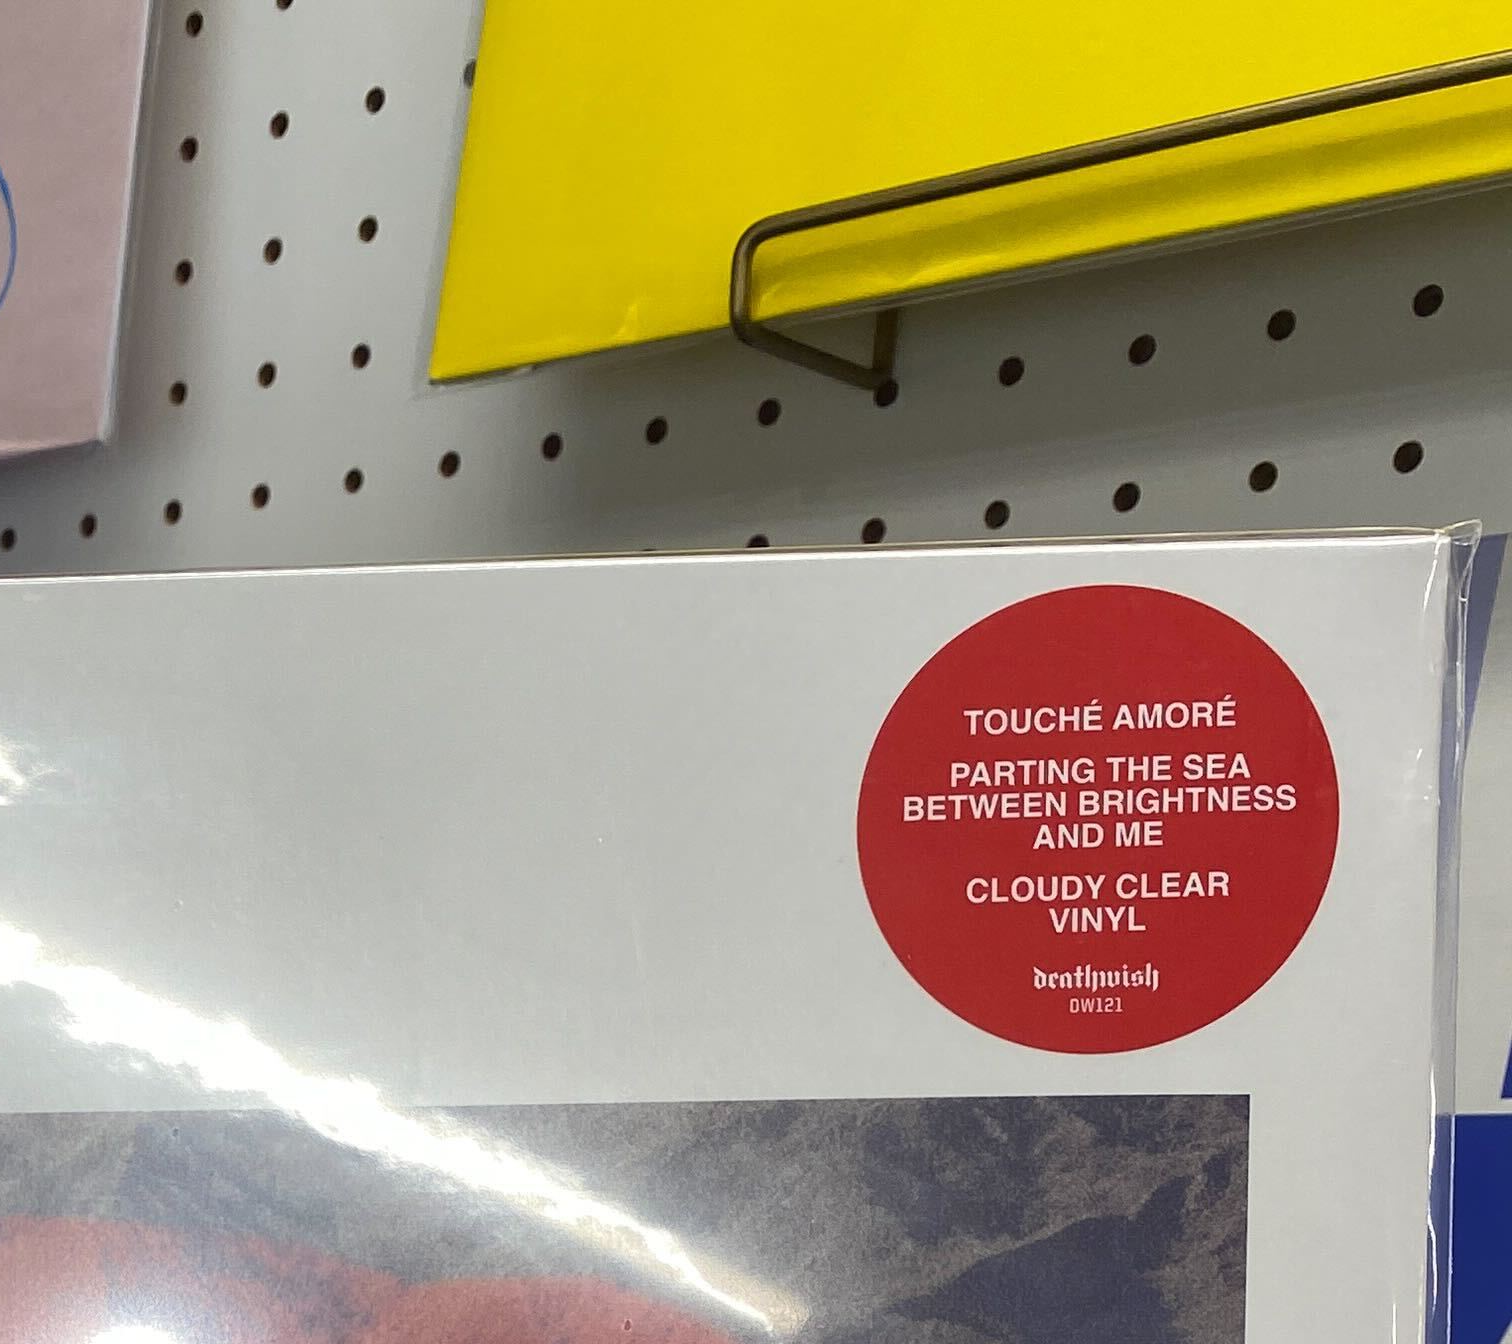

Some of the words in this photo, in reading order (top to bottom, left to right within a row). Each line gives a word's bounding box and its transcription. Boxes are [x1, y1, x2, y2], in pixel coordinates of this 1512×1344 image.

[964, 700, 1103, 735] TOUCHÉ
[1112, 695, 1237, 731] AMORÉ
[950, 757, 1095, 788] PARTING
[1107, 755, 1172, 783] THE
[1183, 753, 1251, 780] SEA
[903, 791, 1067, 823] BETWEEN
[1078, 785, 1297, 817] BRIGHTNESS
[1032, 823, 1104, 850] AND
[1115, 821, 1164, 848] ME
[965, 874, 1105, 904] CLOUDY
[1116, 871, 1230, 899] CLEAR
[1049, 906, 1146, 933] VINYL
[1033, 963, 1160, 993] deathwish
[1069, 997, 1123, 1014] DW121
